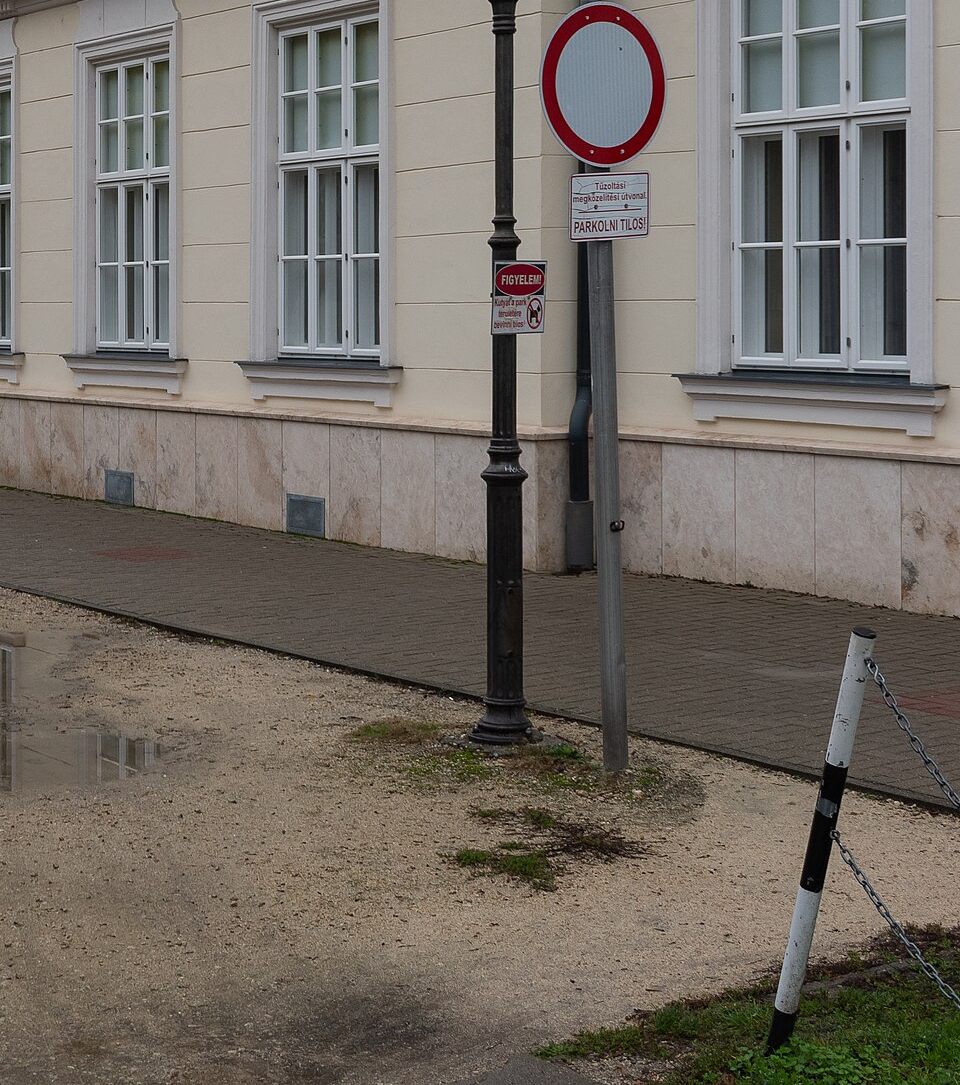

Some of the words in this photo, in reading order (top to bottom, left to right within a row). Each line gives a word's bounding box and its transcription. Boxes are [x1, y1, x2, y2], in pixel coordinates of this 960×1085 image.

[574, 219, 618, 233] PARKOLNI
[620, 217, 646, 230] TILOS!
[501, 274, 542, 285] FIGYELEM!
[515, 298, 527, 307] park
